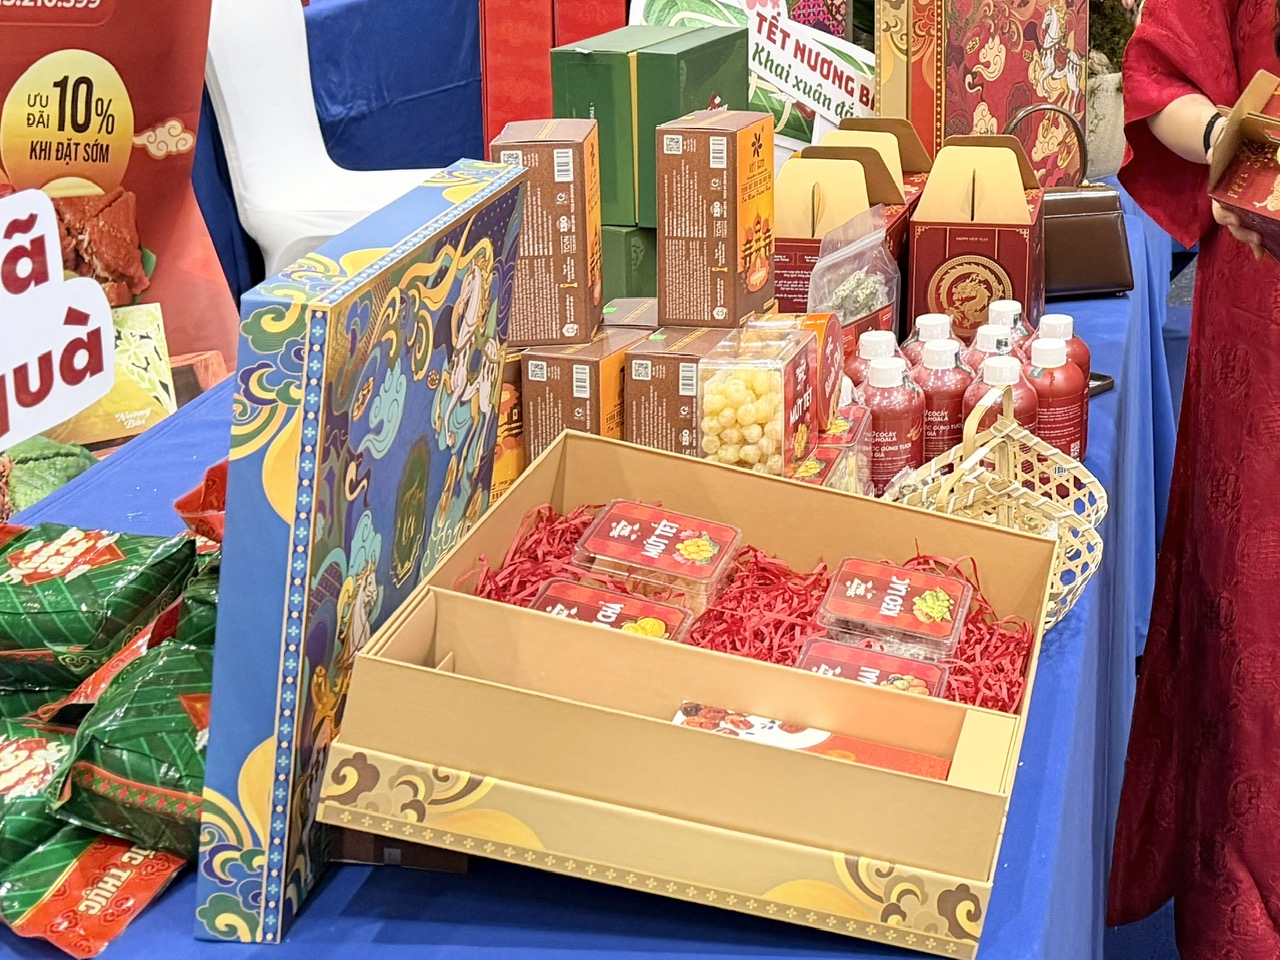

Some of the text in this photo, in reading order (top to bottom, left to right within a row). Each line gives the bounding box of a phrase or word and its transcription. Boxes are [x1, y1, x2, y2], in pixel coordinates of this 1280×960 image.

[756, 10, 791, 51] TẾT
[793, 38, 855, 98] NƯƠNG
[27, 92, 49, 109] ƯU
[752, 42, 860, 119] Khai xuân đắ
[26, 110, 50, 129] ĐÃI
[53, 75, 115, 135] 10%
[29, 137, 110, 166] KHI ĐẶT SỚM
[641, 519, 680, 559] MỨT TẾT
[78, 868, 133, 916] THỰC
